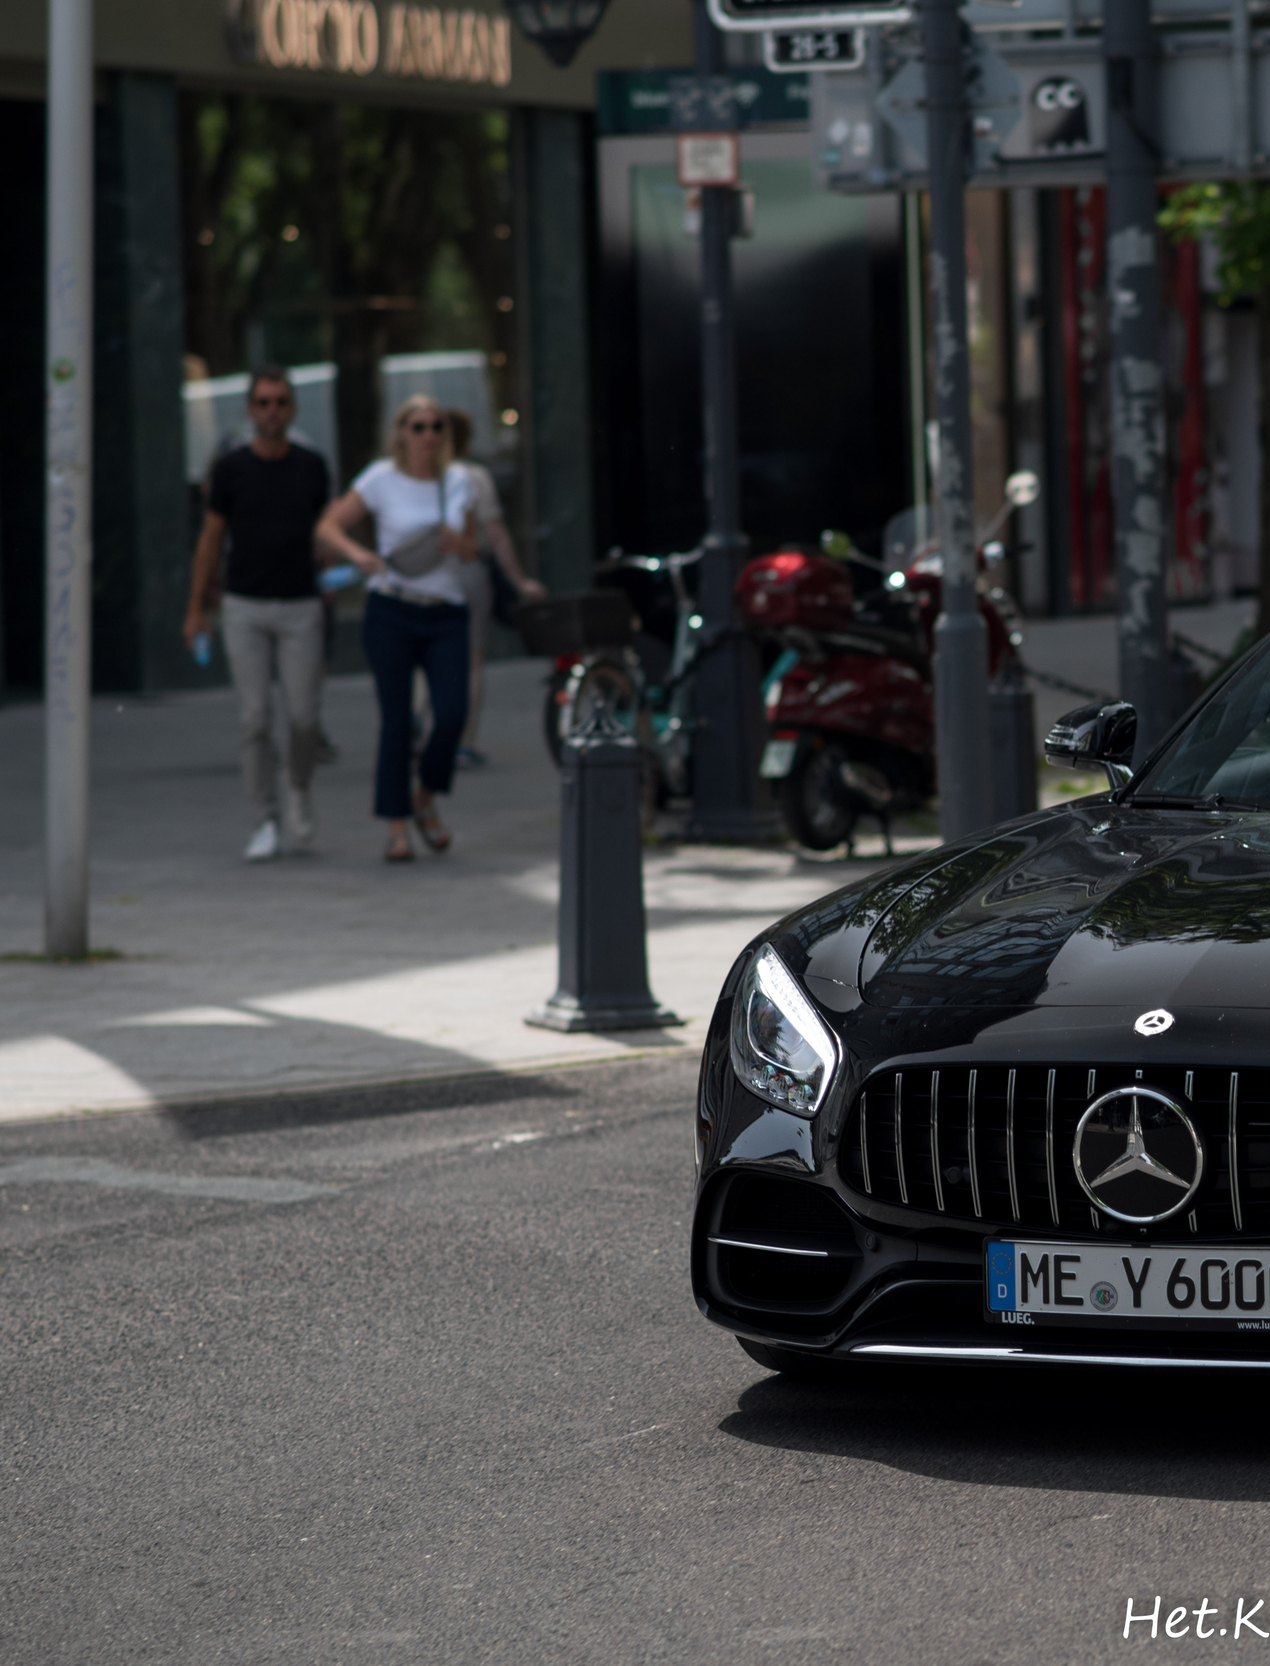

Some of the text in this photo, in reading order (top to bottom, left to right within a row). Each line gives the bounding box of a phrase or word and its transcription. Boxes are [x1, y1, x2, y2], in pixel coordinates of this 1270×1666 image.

[1020, 1252, 1084, 1306] ME
[1121, 1256, 1151, 1308] Y
[997, 1283, 1008, 1299] D
[1001, 1311, 1035, 1325] LUEG.
